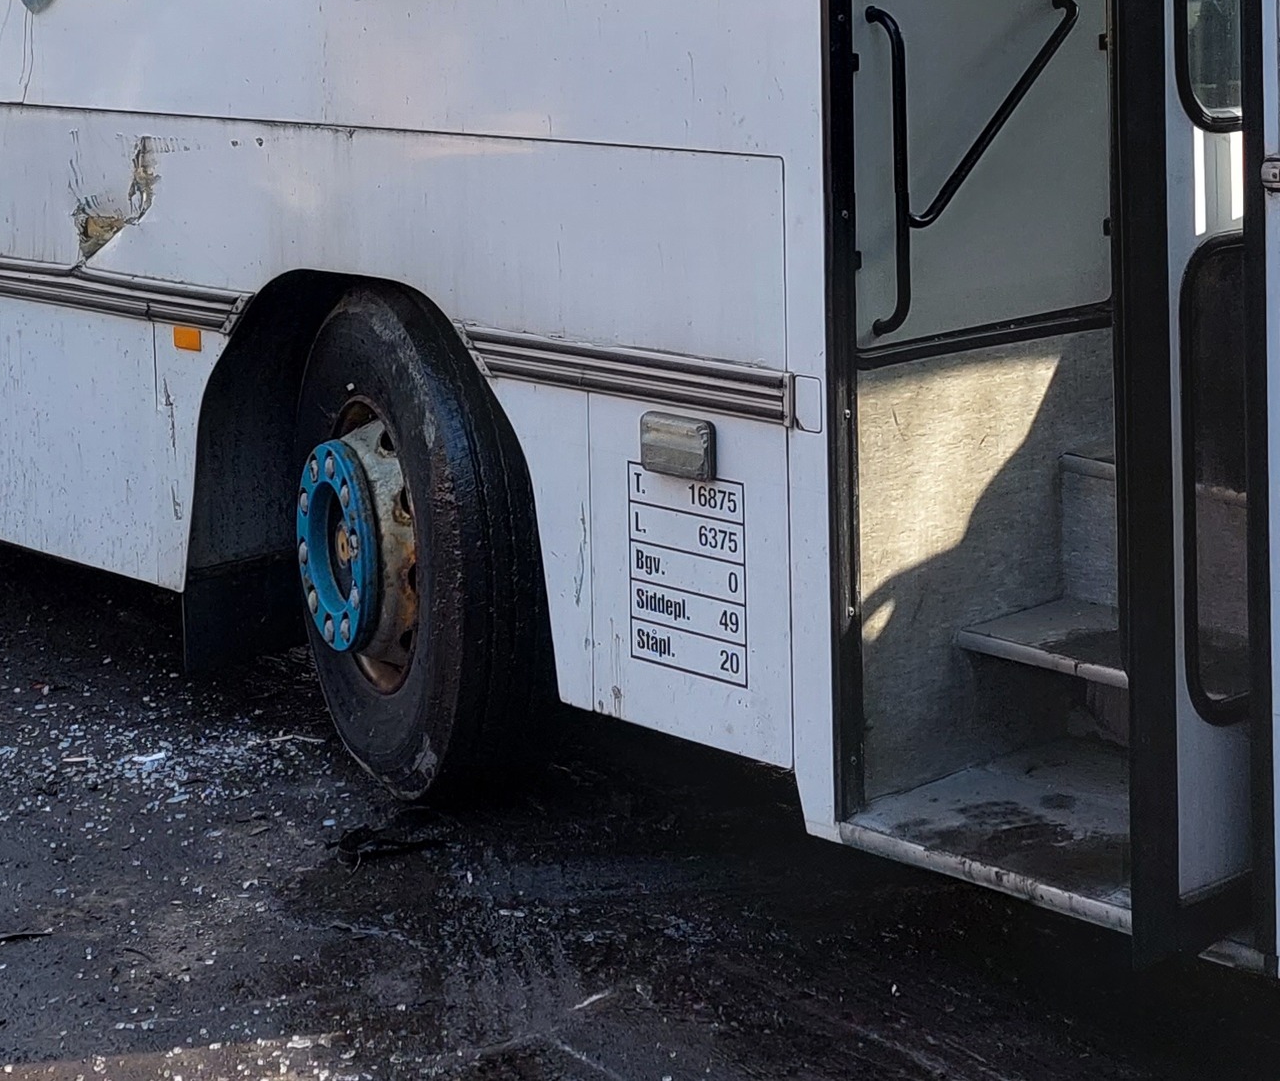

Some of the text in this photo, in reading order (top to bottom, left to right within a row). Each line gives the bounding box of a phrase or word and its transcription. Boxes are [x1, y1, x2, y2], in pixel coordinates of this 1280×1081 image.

[634, 472, 737, 514] T. 16875
[634, 511, 738, 553] L. 6375
[636, 549, 738, 594] Bgv. 0
[636, 588, 739, 634] Siddepl. 49
[637, 628, 740, 674] Ståpl. 20
